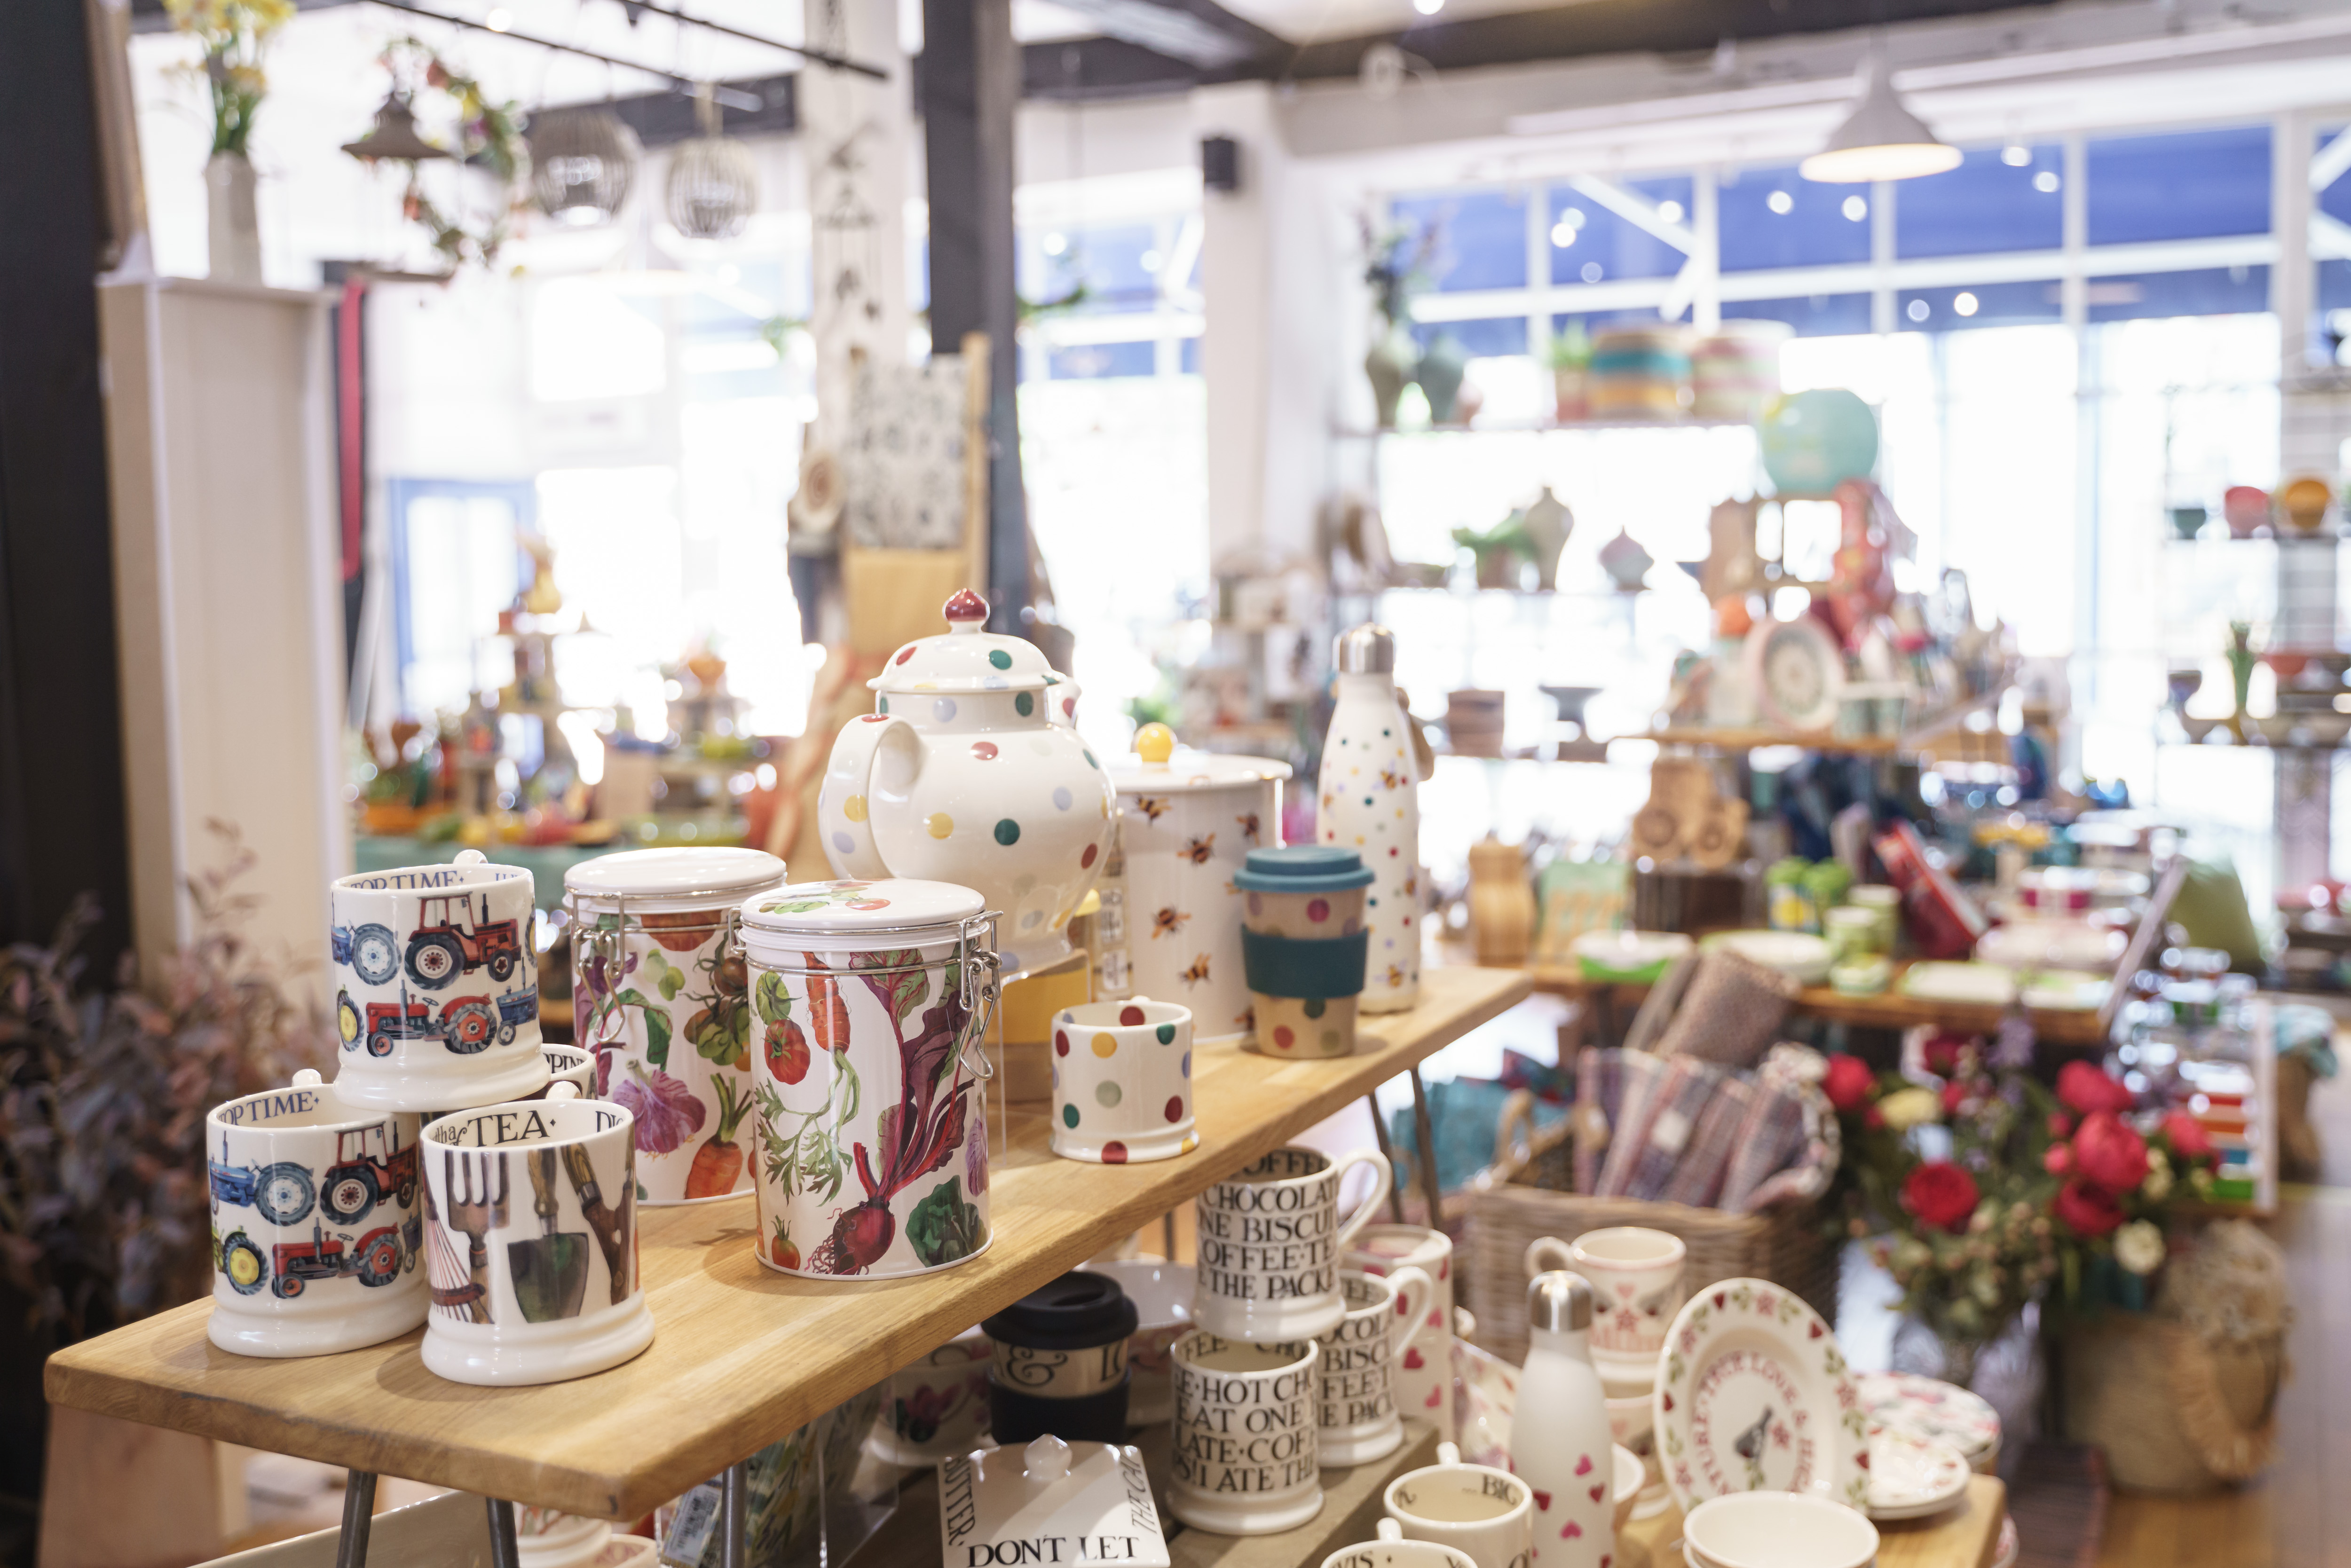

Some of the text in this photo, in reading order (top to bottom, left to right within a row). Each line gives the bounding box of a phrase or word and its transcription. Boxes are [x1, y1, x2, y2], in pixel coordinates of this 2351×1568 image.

[391, 871, 458, 889] TIME
[246, 1091, 313, 1122] TIME
[467, 1110, 550, 1147] TEA
[1210, 1269, 1257, 1299] THE
[1201, 1376, 1270, 1404] HOT
[1177, 1396, 1236, 1433] EAT
[1246, 1399, 1304, 1434] ONE
[1215, 1465, 1274, 1492] ATE
[967, 1534, 1140, 1568] DON'T LET
